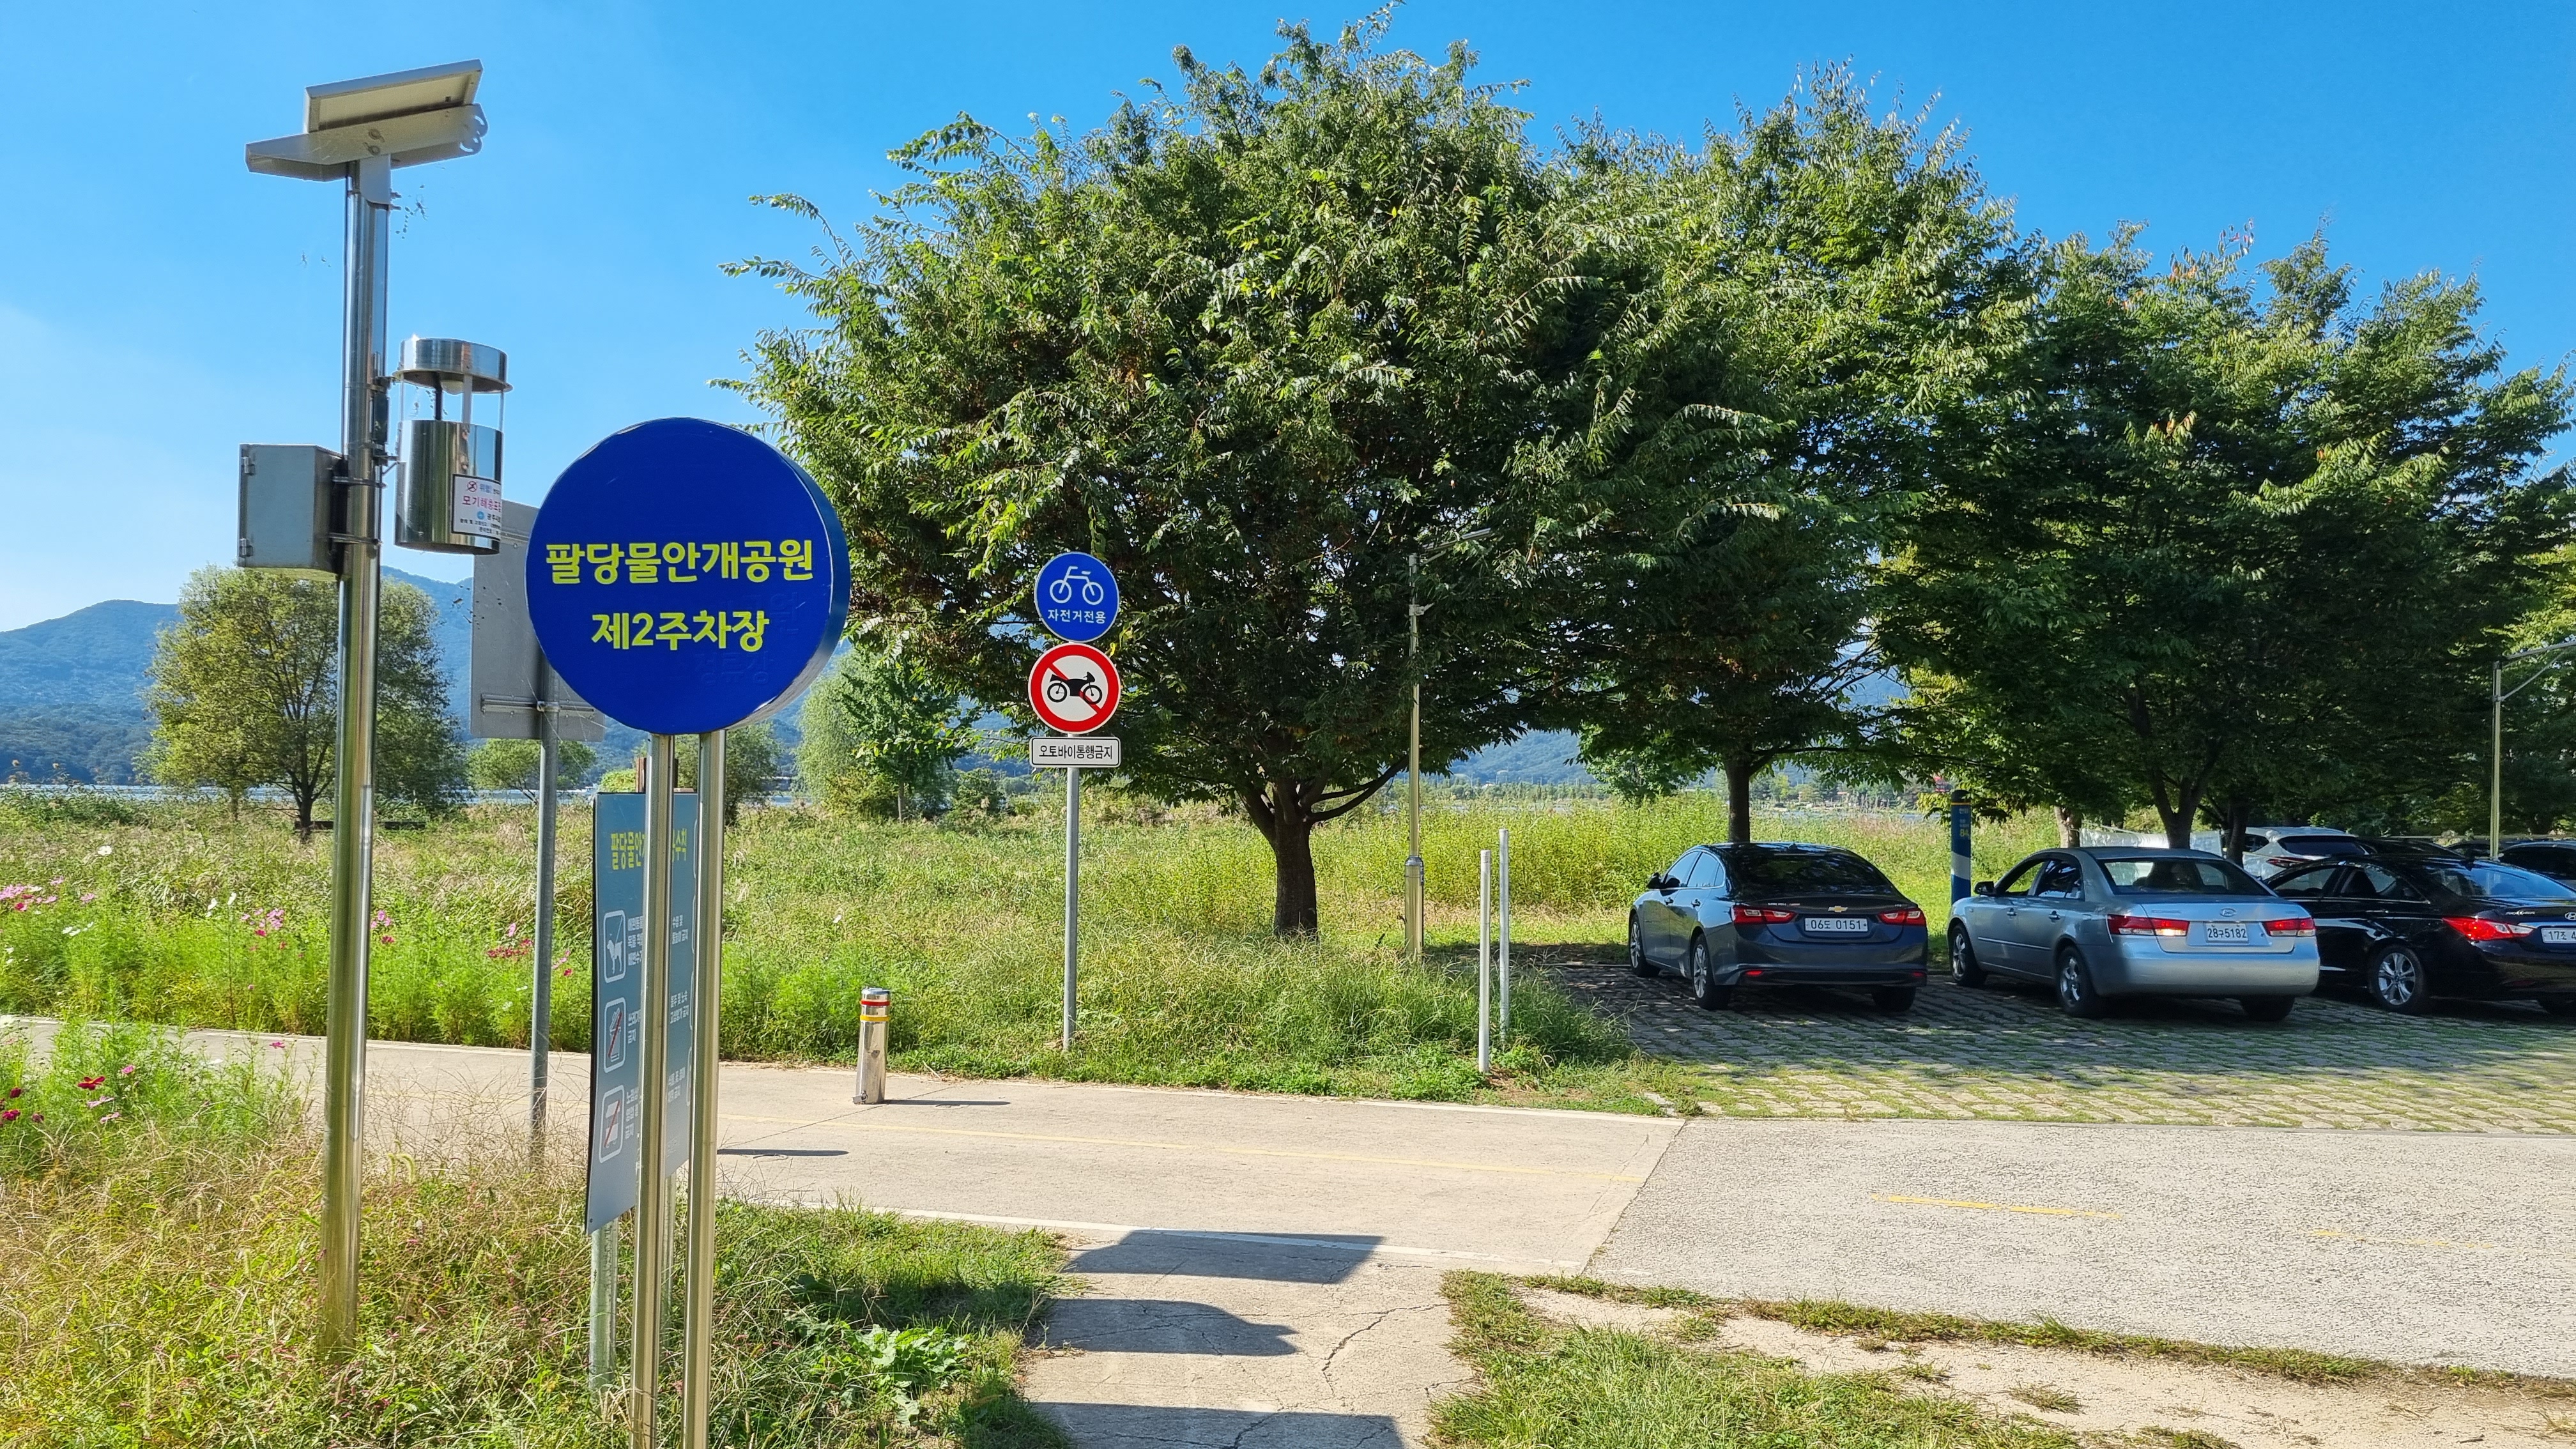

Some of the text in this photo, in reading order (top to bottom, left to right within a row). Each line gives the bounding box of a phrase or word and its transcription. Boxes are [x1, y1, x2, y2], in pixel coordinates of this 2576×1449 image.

[546, 540, 813, 585] 팔당물안개공원
[1047, 609, 1107, 624] 자전거전용
[592, 610, 770, 652] 제2주차장
[1038, 744, 1114, 760] 오토바이통행금지
[1811, 919, 1860, 930] 06도 0151
[2207, 928, 2247, 939] 28구5182
[2548, 930, 2567, 940] 17조
[627, 1028, 636, 1044] 금지
[625, 1123, 634, 1140] 금지
